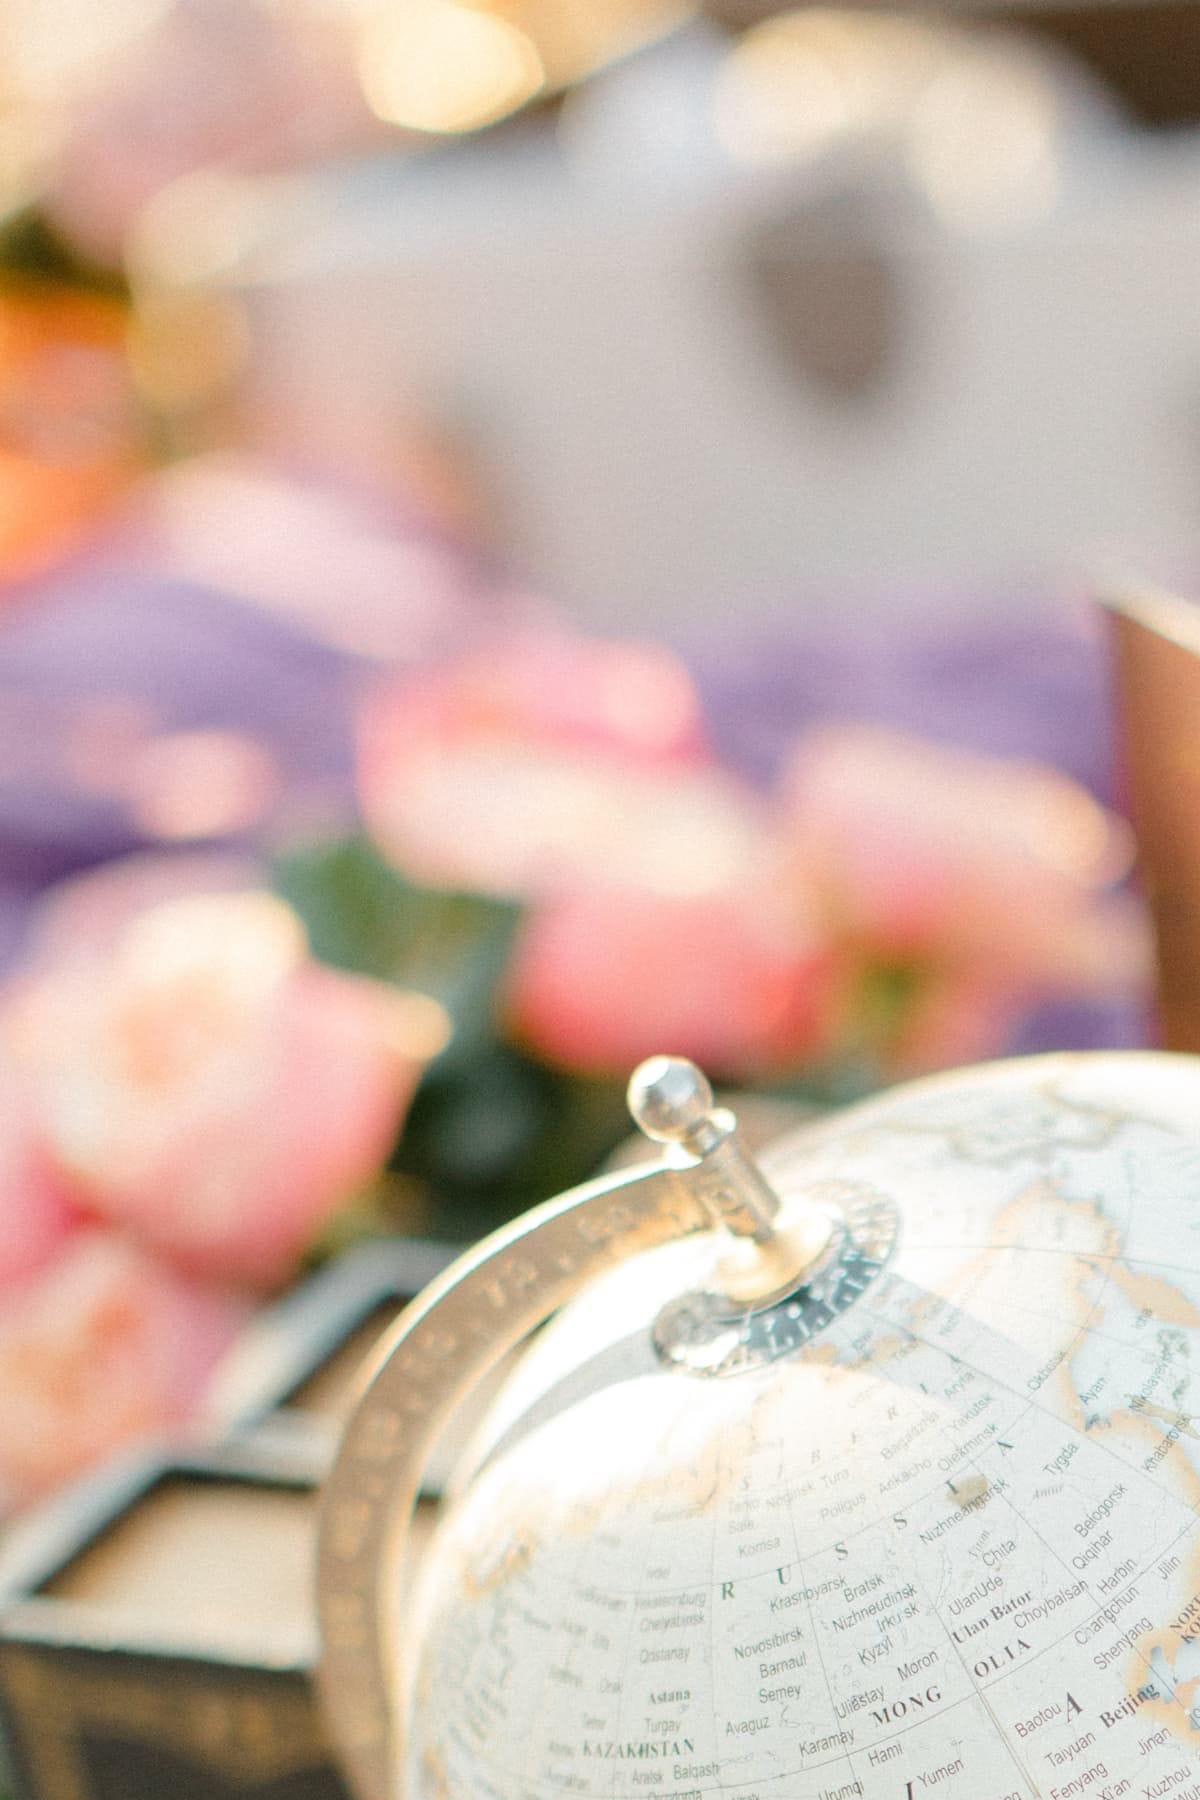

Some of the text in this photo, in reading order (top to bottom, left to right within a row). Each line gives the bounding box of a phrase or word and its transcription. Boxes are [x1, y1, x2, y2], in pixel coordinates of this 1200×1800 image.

[1043, 1442, 1080, 1475] Tygda
[1074, 1483, 1128, 1538] Belogorsk
[982, 1539, 1017, 1567] Chita
[1072, 1530, 1114, 1570] Qiqihar
[1096, 1558, 1138, 1596] Harbin
[1158, 1555, 1181, 1581] Jilin
[844, 1573, 885, 1603] Bratsk
[1014, 1579, 1089, 1629] Choybalsan
[953, 1590, 1032, 1644] Ulan Bator
[1074, 1584, 1140, 1646] Changchun
[734, 1627, 804, 1660] Novosibirsk
[859, 1636, 894, 1666] Kyzyl
[1094, 1617, 1154, 1670] Shenyang
[898, 1650, 939, 1681] Moron
[759, 1685, 801, 1703] Semey
[1099, 1684, 1160, 1729] Beijing
[1015, 1703, 1062, 1738] Baotou
[800, 1728, 855, 1757] Karamay
[1044, 1730, 1096, 1768] Taiyuan
[1138, 1726, 1173, 1757] Jinan
[919, 1758, 964, 1788] Yumen
